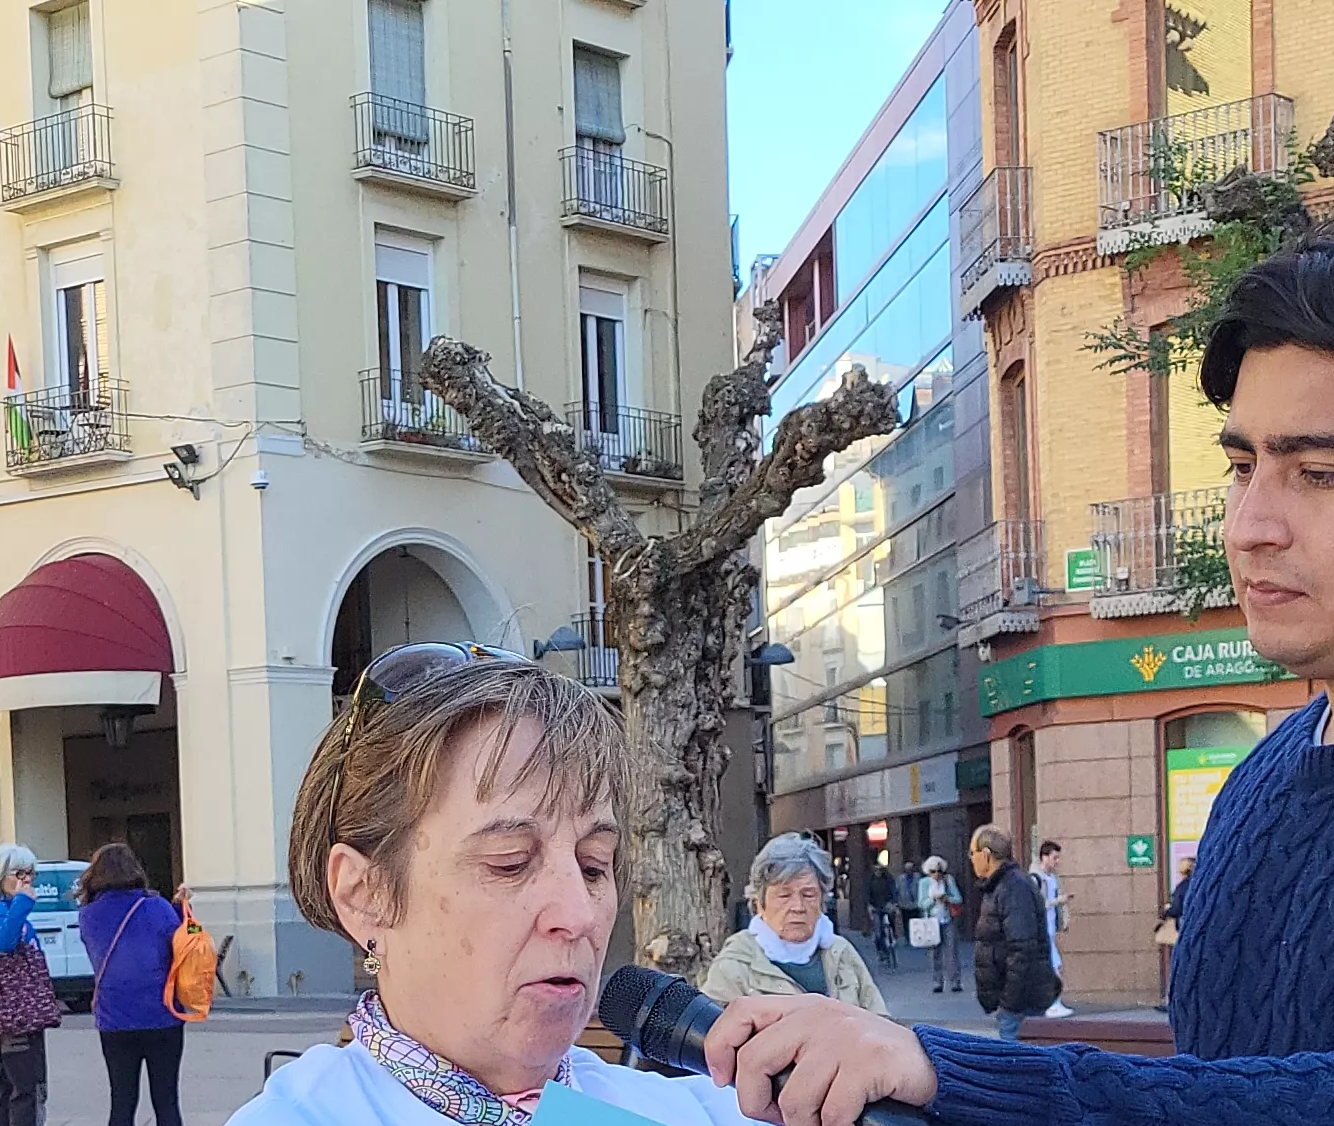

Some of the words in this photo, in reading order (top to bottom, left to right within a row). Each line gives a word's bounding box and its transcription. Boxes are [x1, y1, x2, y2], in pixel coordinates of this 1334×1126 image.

[1171, 644, 1215, 664] CAJA
[1218, 640, 1259, 660] RUR
[1184, 664, 1203, 679] DE
[33, 883, 58, 896] oltia
